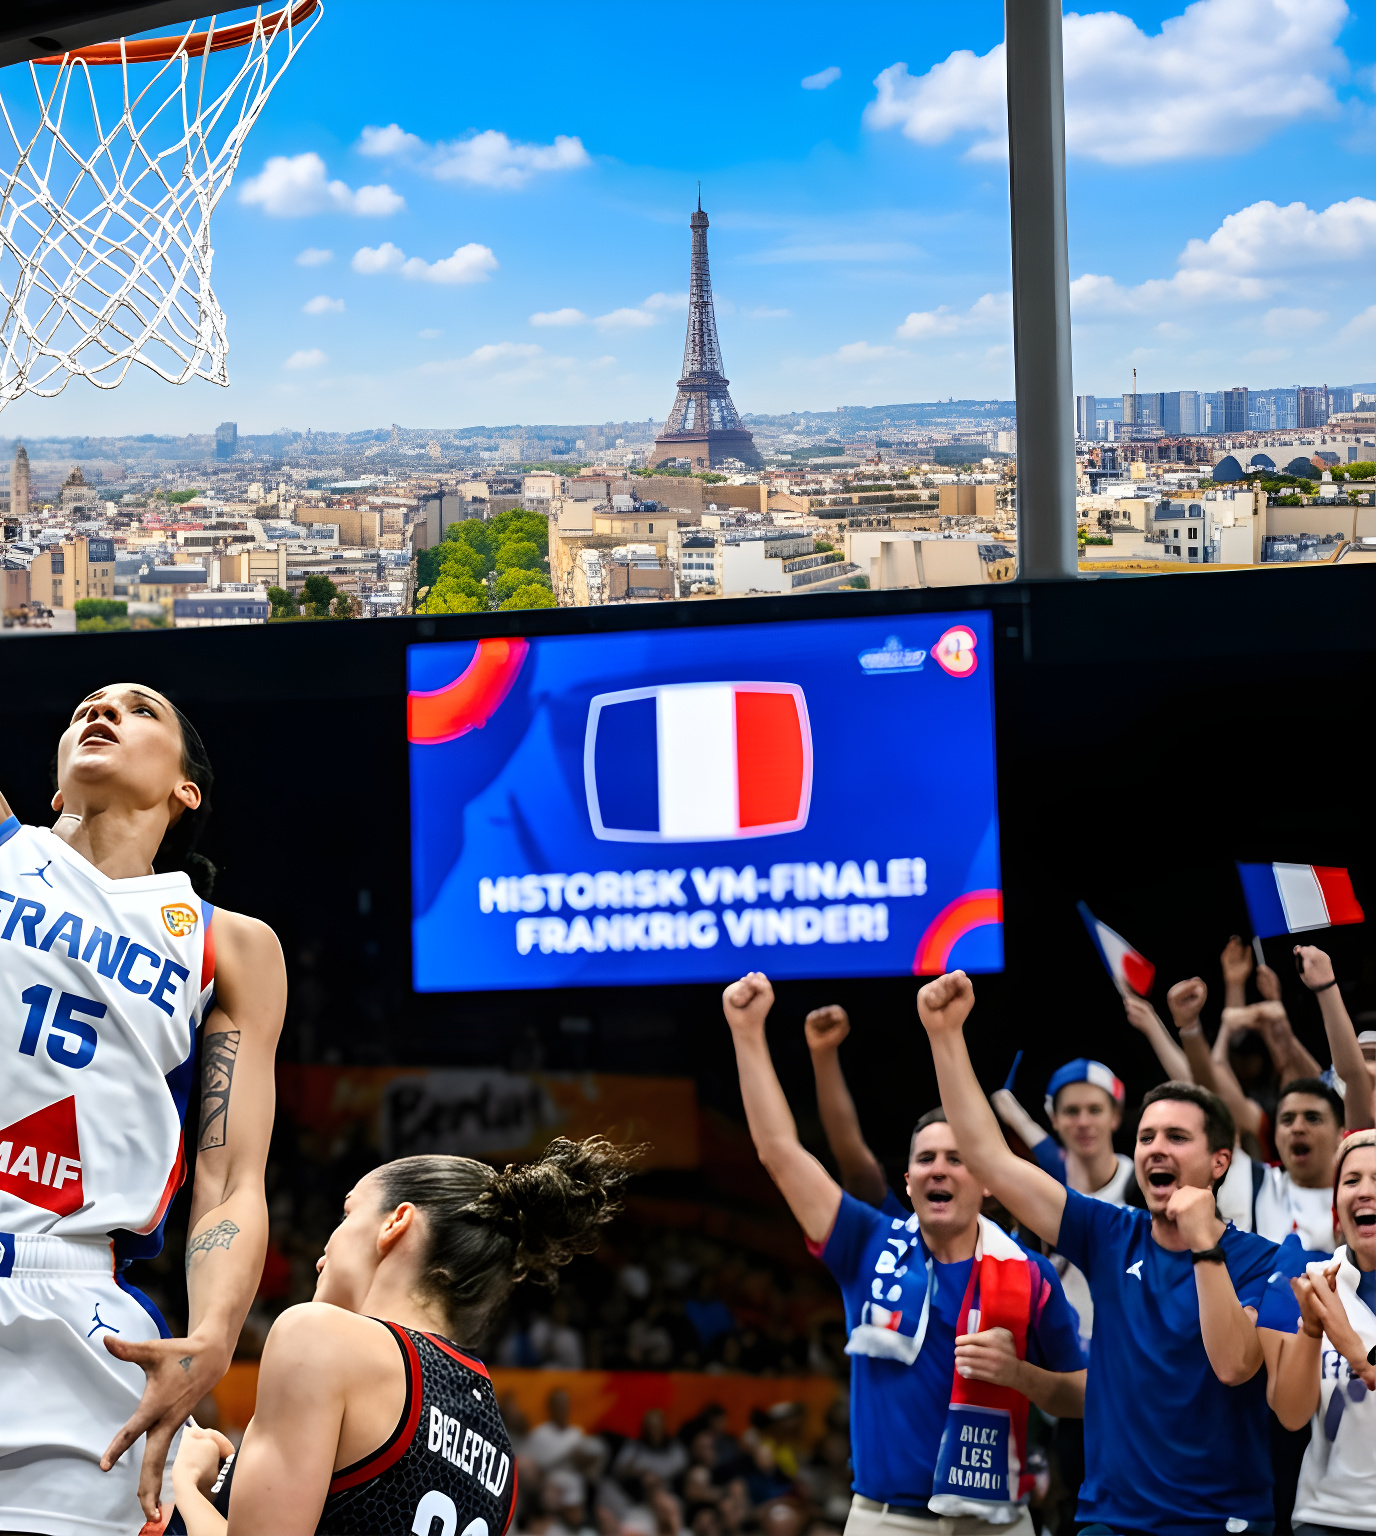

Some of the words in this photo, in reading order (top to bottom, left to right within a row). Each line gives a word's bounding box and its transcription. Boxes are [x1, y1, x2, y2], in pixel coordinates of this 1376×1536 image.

[479, 868, 688, 914] HISTORISK
[690, 857, 927, 906] VM-FINALE!
[516, 909, 719, 955] FRANKRIG
[722, 902, 889, 947] VINDER!
[20, 984, 108, 1070] 15
